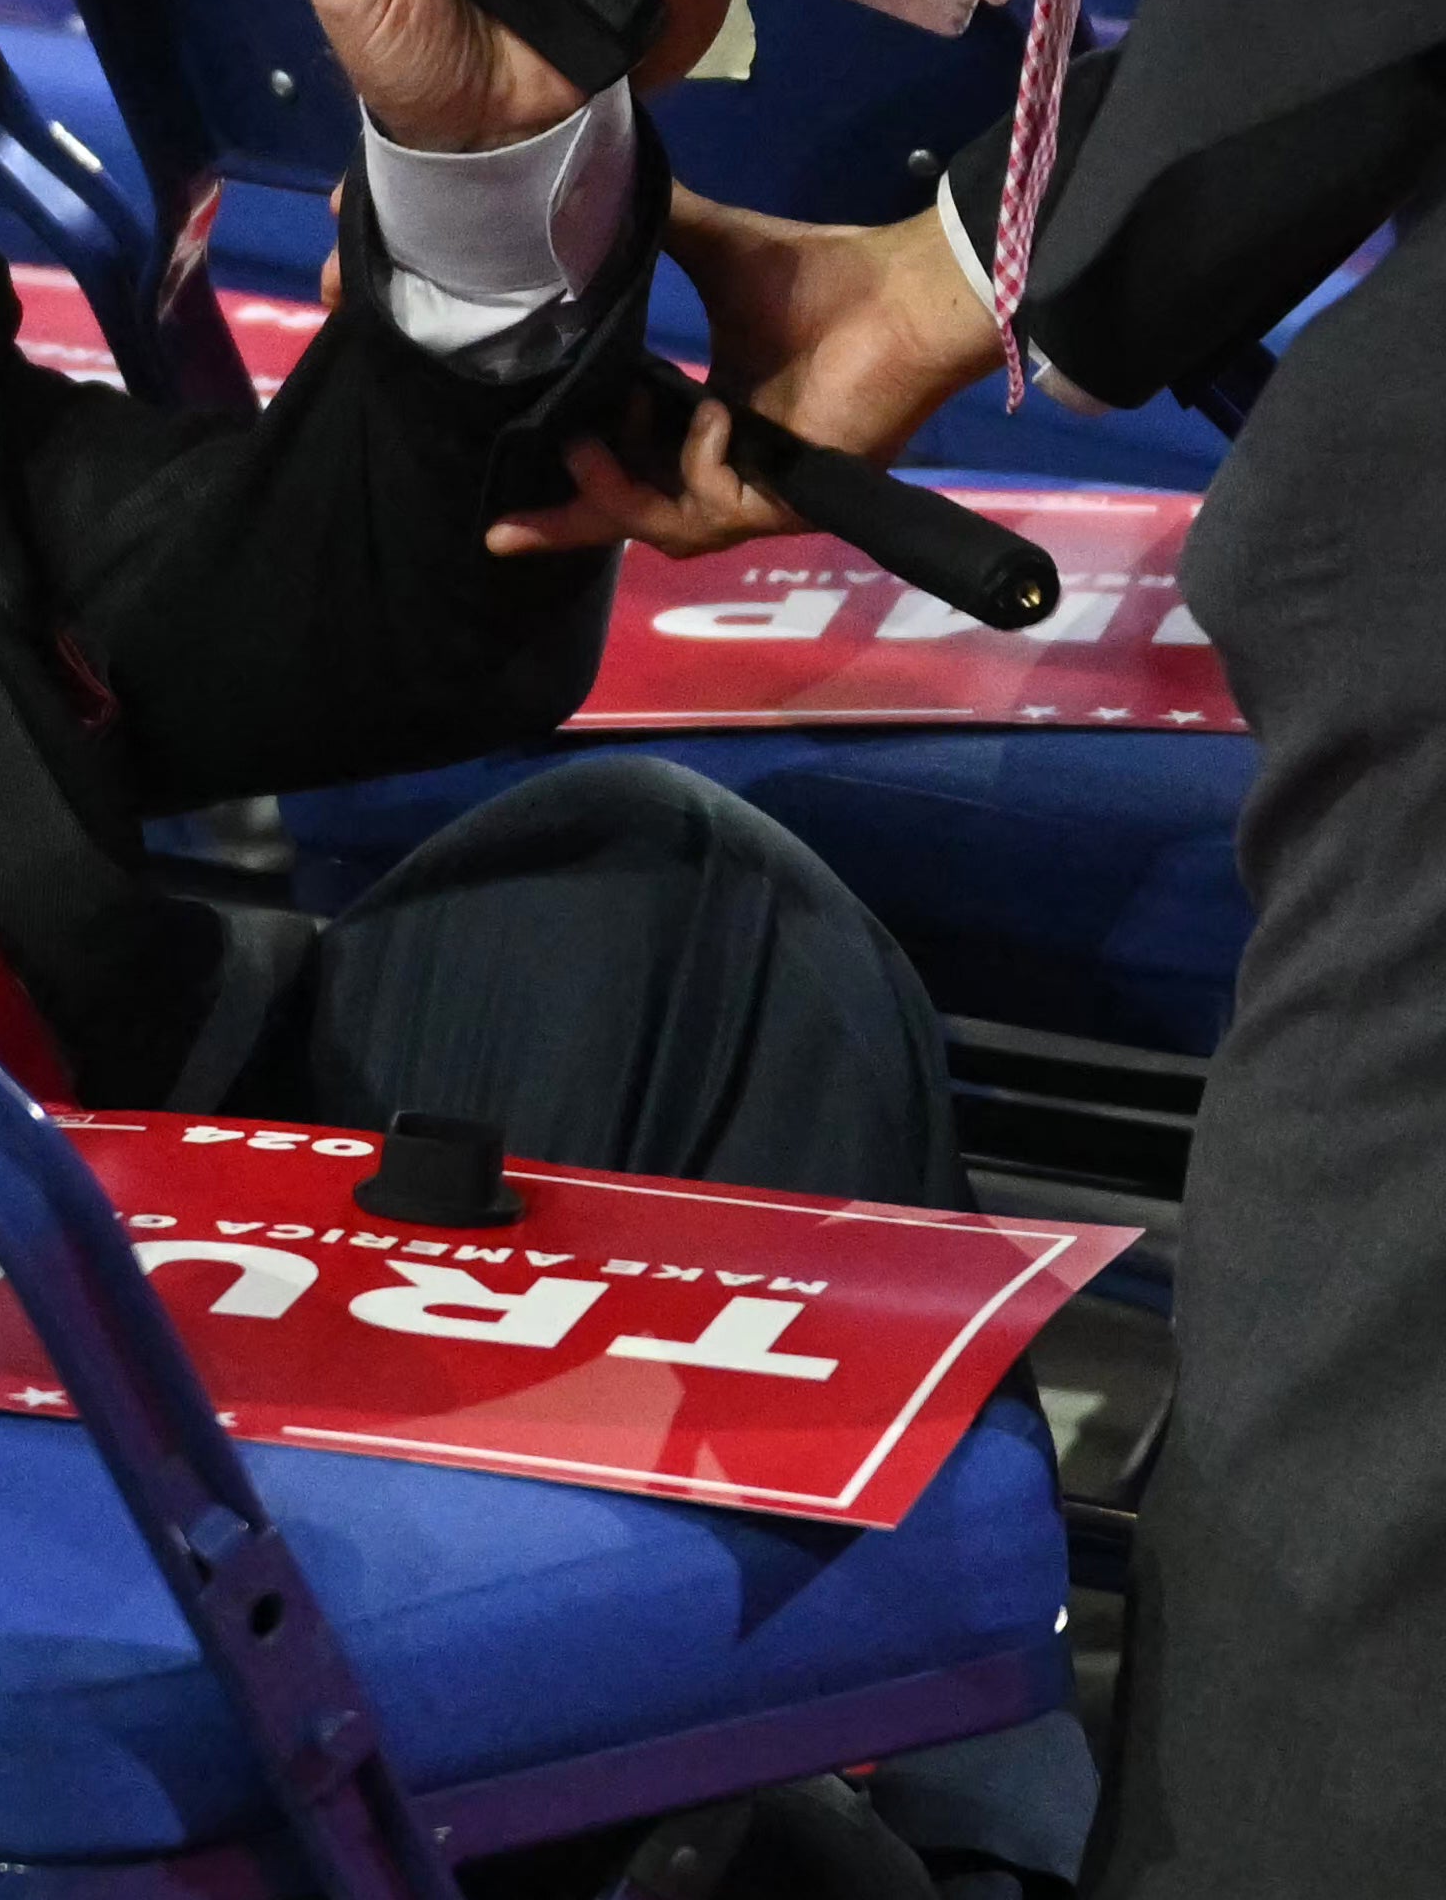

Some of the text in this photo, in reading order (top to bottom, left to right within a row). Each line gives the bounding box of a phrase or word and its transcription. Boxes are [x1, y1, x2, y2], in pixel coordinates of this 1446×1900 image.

[180, 1125, 376, 1159] 024
[214, 1218, 832, 1297] MAKE AMERICA
